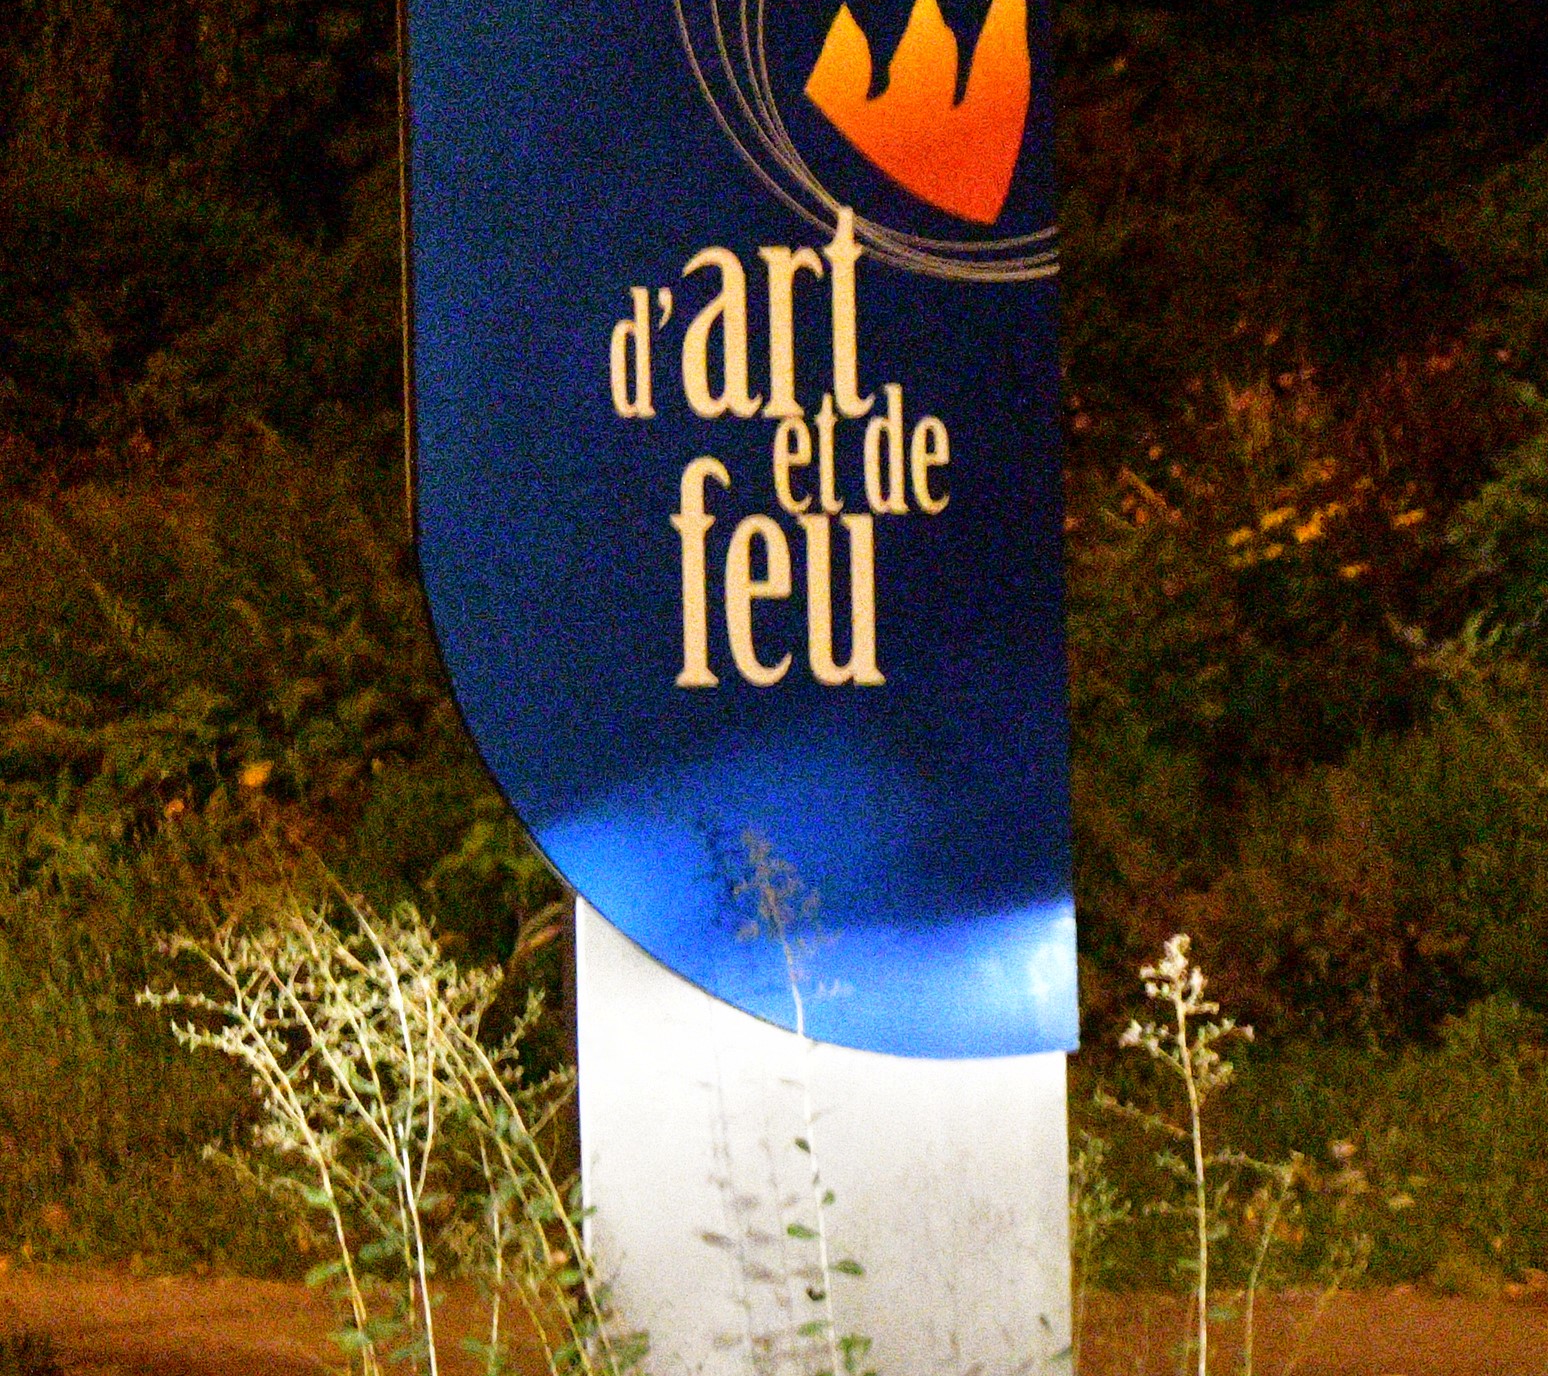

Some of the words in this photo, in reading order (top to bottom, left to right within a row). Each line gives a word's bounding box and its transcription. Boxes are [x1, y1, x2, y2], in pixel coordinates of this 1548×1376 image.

[609, 205, 876, 420] d'art
[773, 392, 846, 516] et
[863, 382, 951, 515] de
[669, 455, 887, 687] feu
